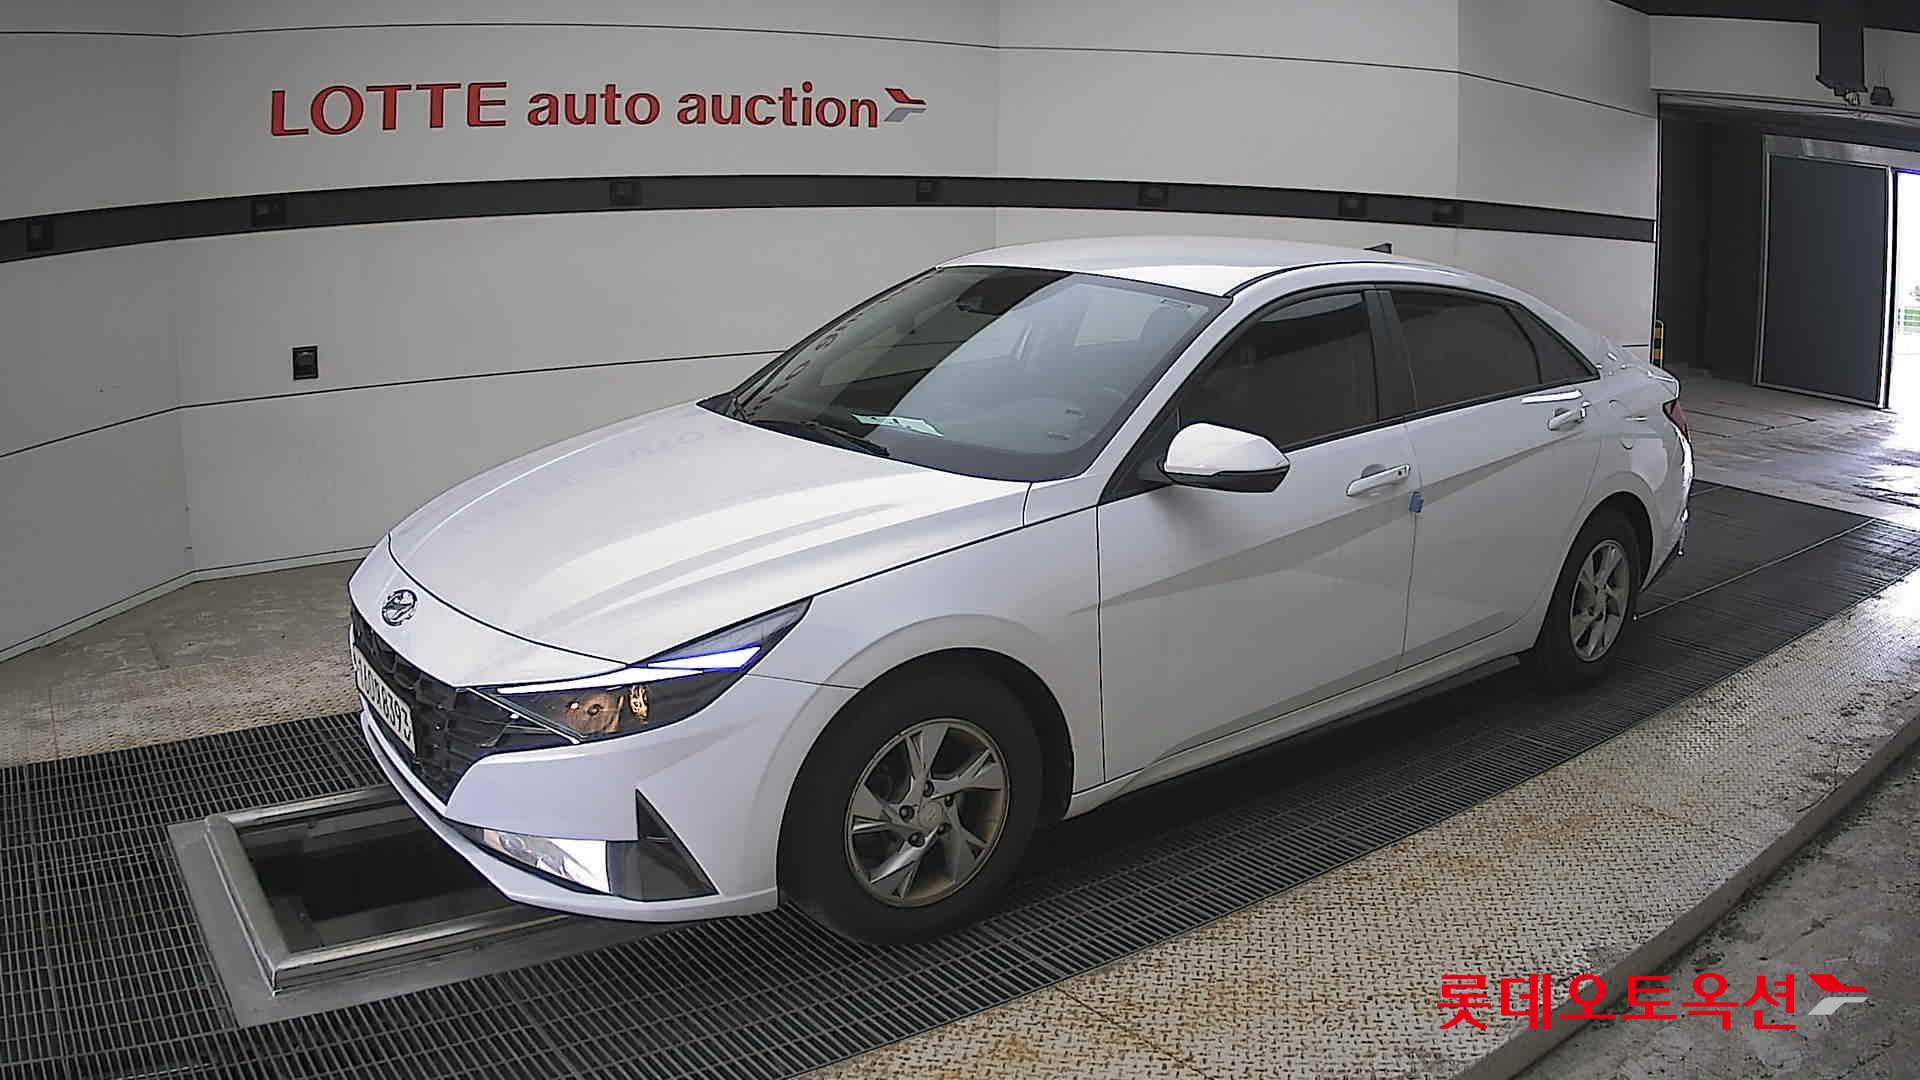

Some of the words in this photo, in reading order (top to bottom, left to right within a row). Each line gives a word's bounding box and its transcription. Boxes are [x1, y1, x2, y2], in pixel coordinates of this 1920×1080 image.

[270, 81, 507, 136] LOTTE
[527, 83, 661, 126] auto
[676, 81, 880, 128] auction
